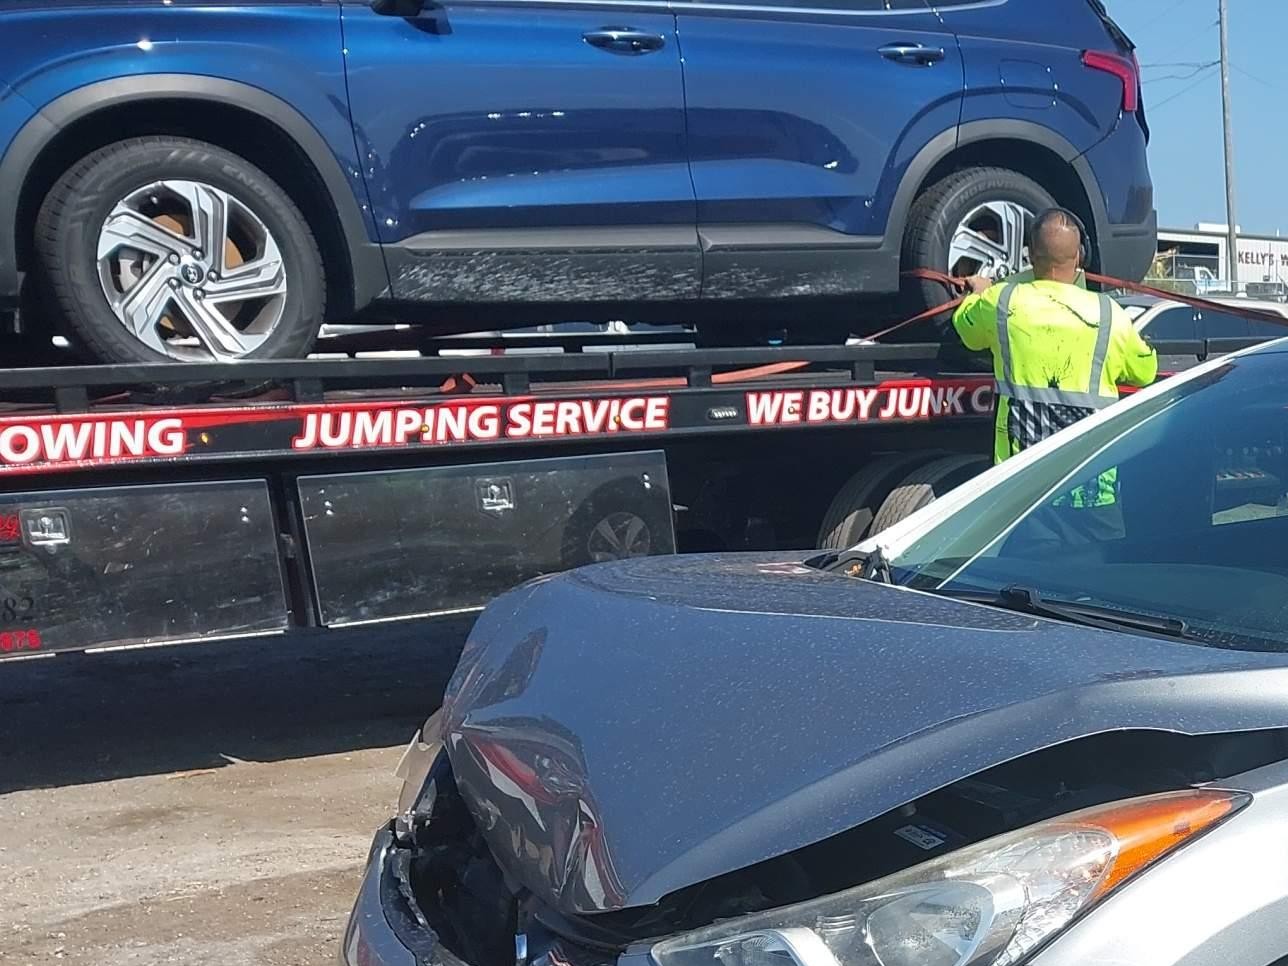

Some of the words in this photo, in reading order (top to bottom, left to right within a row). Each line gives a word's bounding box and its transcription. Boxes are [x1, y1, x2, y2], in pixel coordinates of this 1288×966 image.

[294, 406, 499, 448] JUMPING
[506, 397, 669, 437] SERVICE
[747, 391, 803, 425] WE
[808, 390, 879, 422] BUY
[879, 386, 965, 418] JUNK
